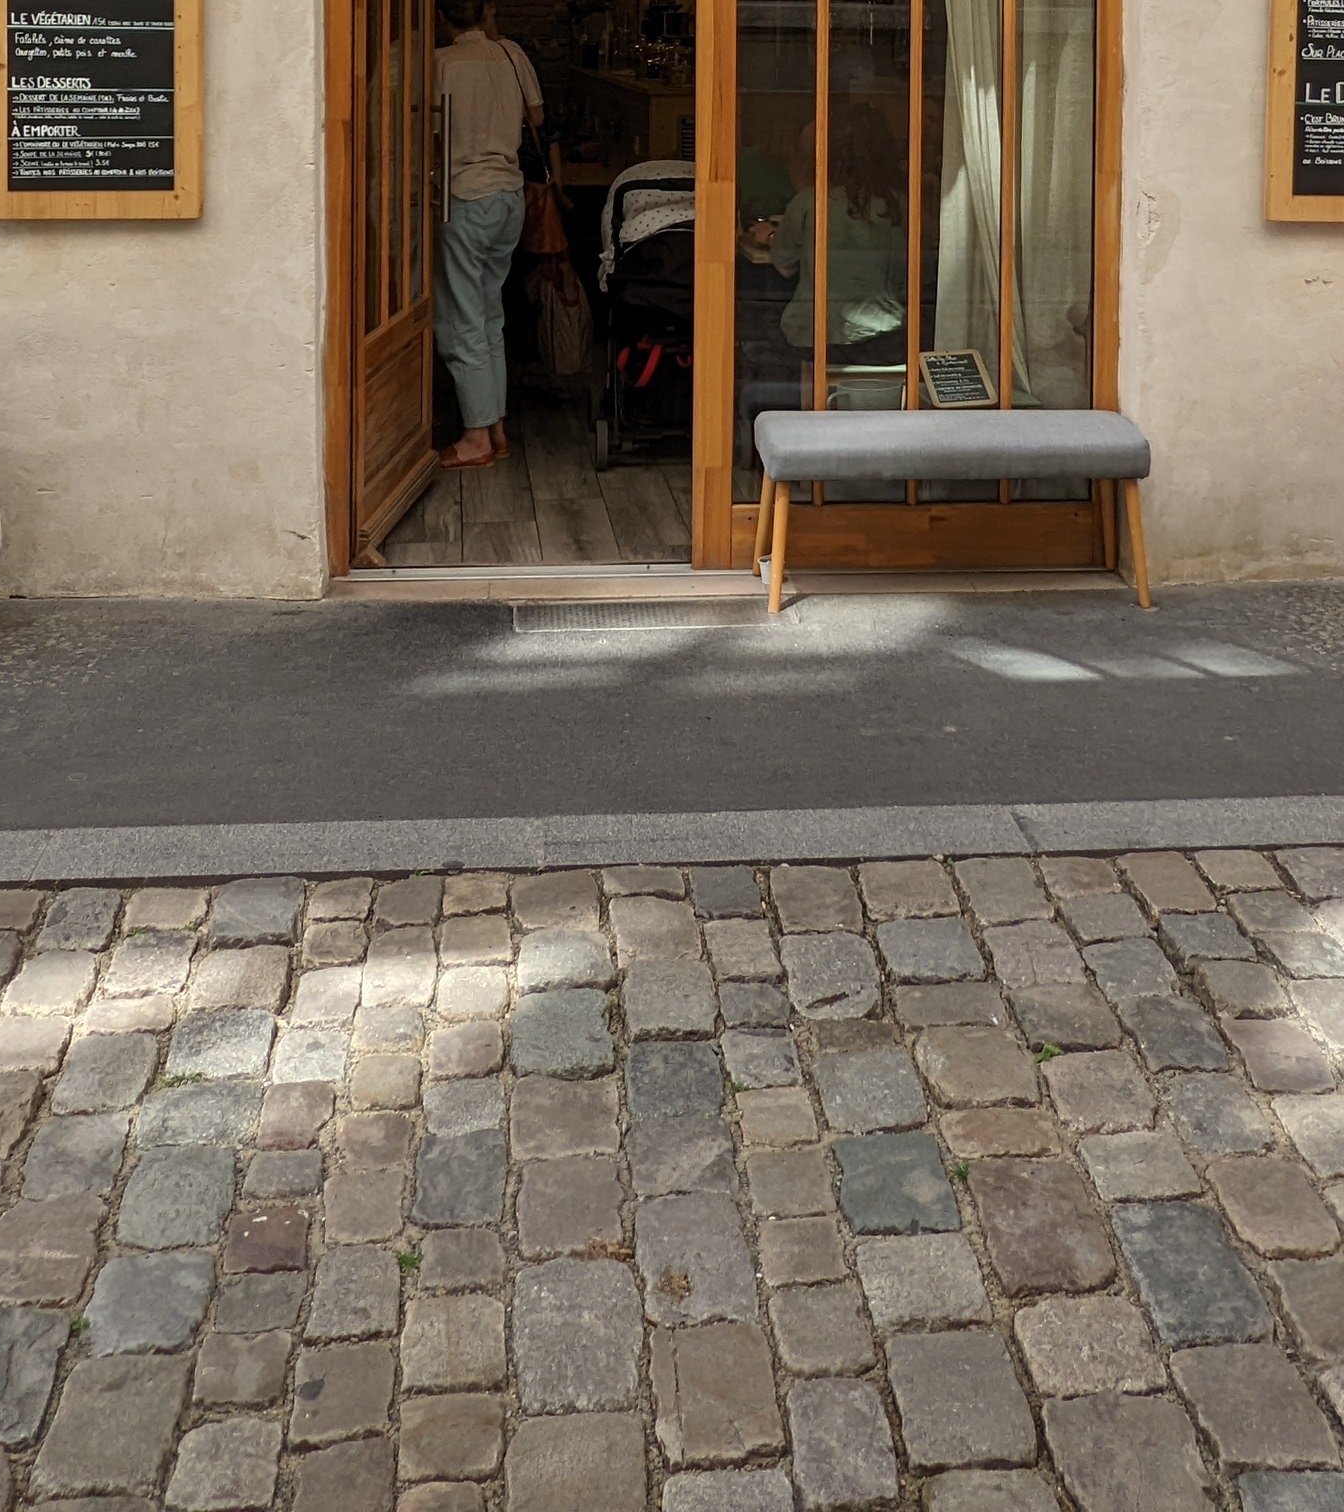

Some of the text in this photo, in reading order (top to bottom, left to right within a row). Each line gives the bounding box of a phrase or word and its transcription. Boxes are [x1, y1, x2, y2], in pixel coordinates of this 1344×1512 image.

[11, 13, 28, 25] LE
[31, 10, 91, 25] VÉGÉTARIEN
[77, 36, 86, 44] de
[76, 49, 92, 59] pois
[97, 49, 107, 58] et
[1301, 43, 1323, 58] SUR
[11, 76, 91, 89] LES DESSERTS
[1305, 82, 1330, 103] LE
[11, 120, 81, 137] À EMPORTER
